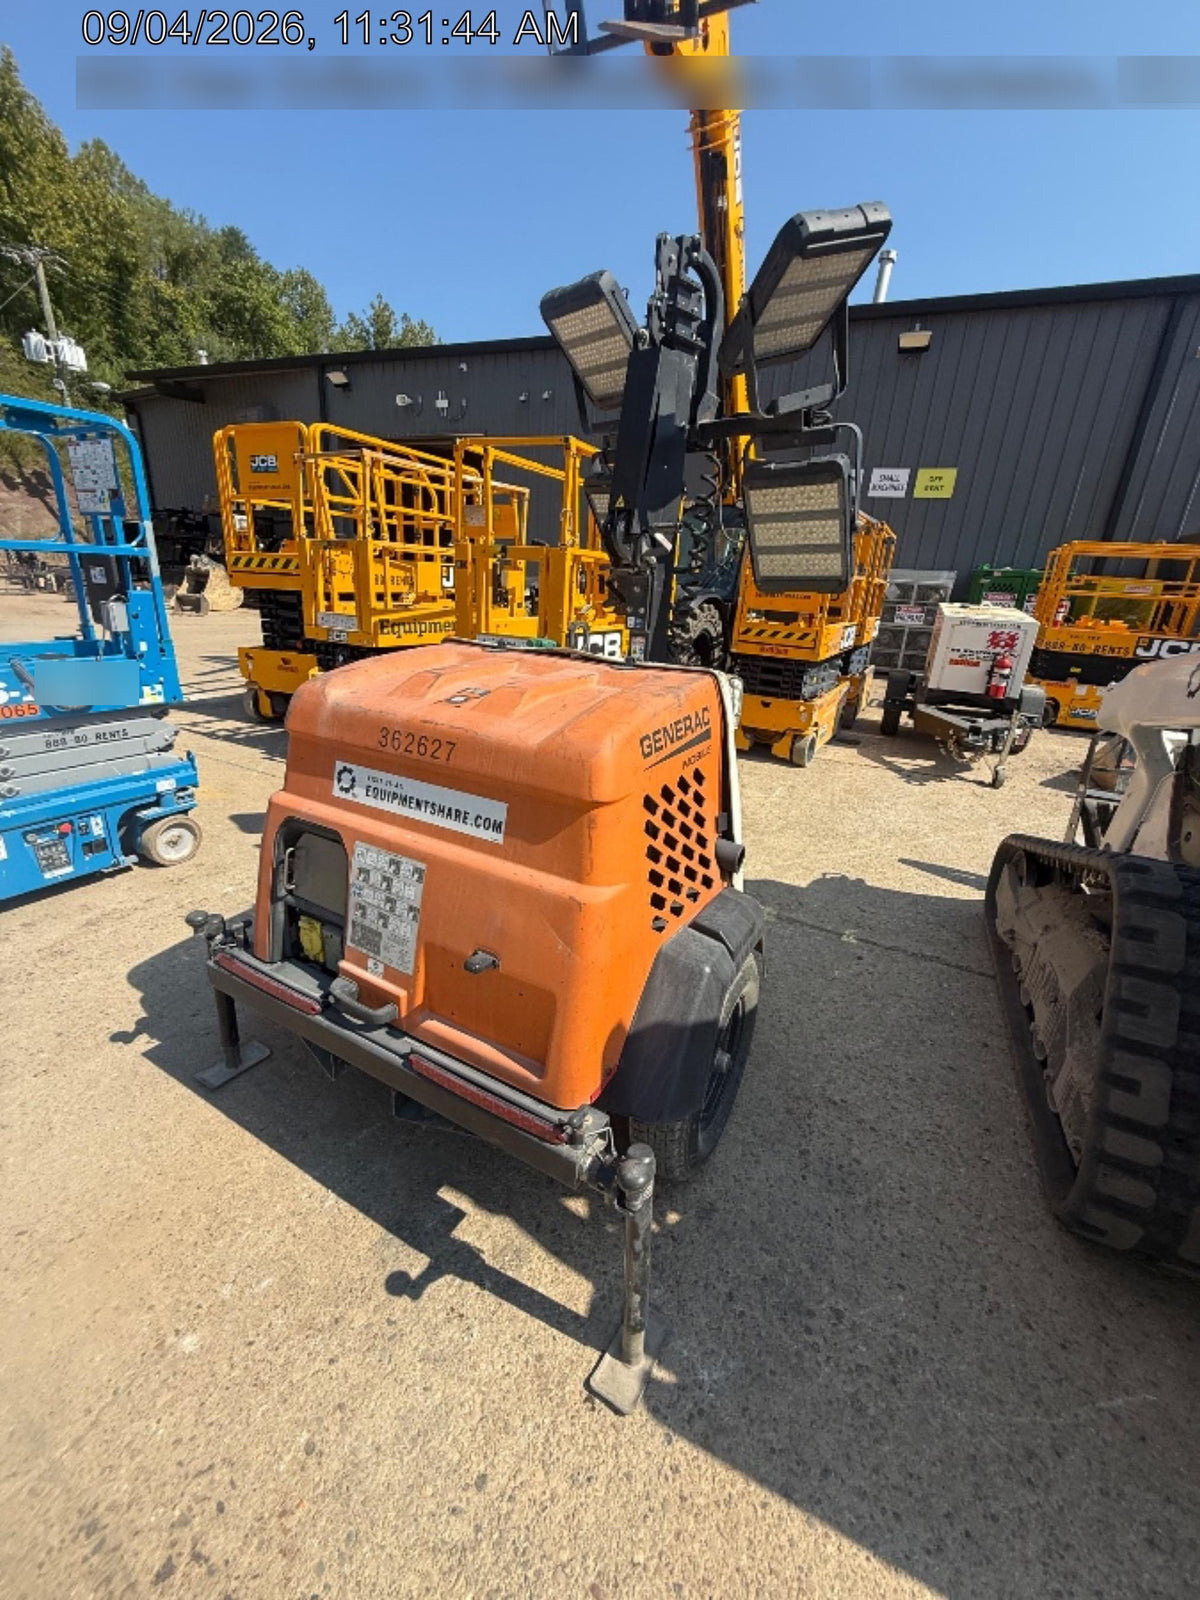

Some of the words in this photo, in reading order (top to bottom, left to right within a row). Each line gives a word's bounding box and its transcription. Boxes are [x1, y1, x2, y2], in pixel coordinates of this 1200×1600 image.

[250, 455, 276, 466] JCB
[1136, 639, 1200, 659] JC
[378, 726, 456, 762] 362627
[640, 706, 711, 759] GENERAC
[365, 785, 503, 834] EQUIPMENTSHARE.COM
